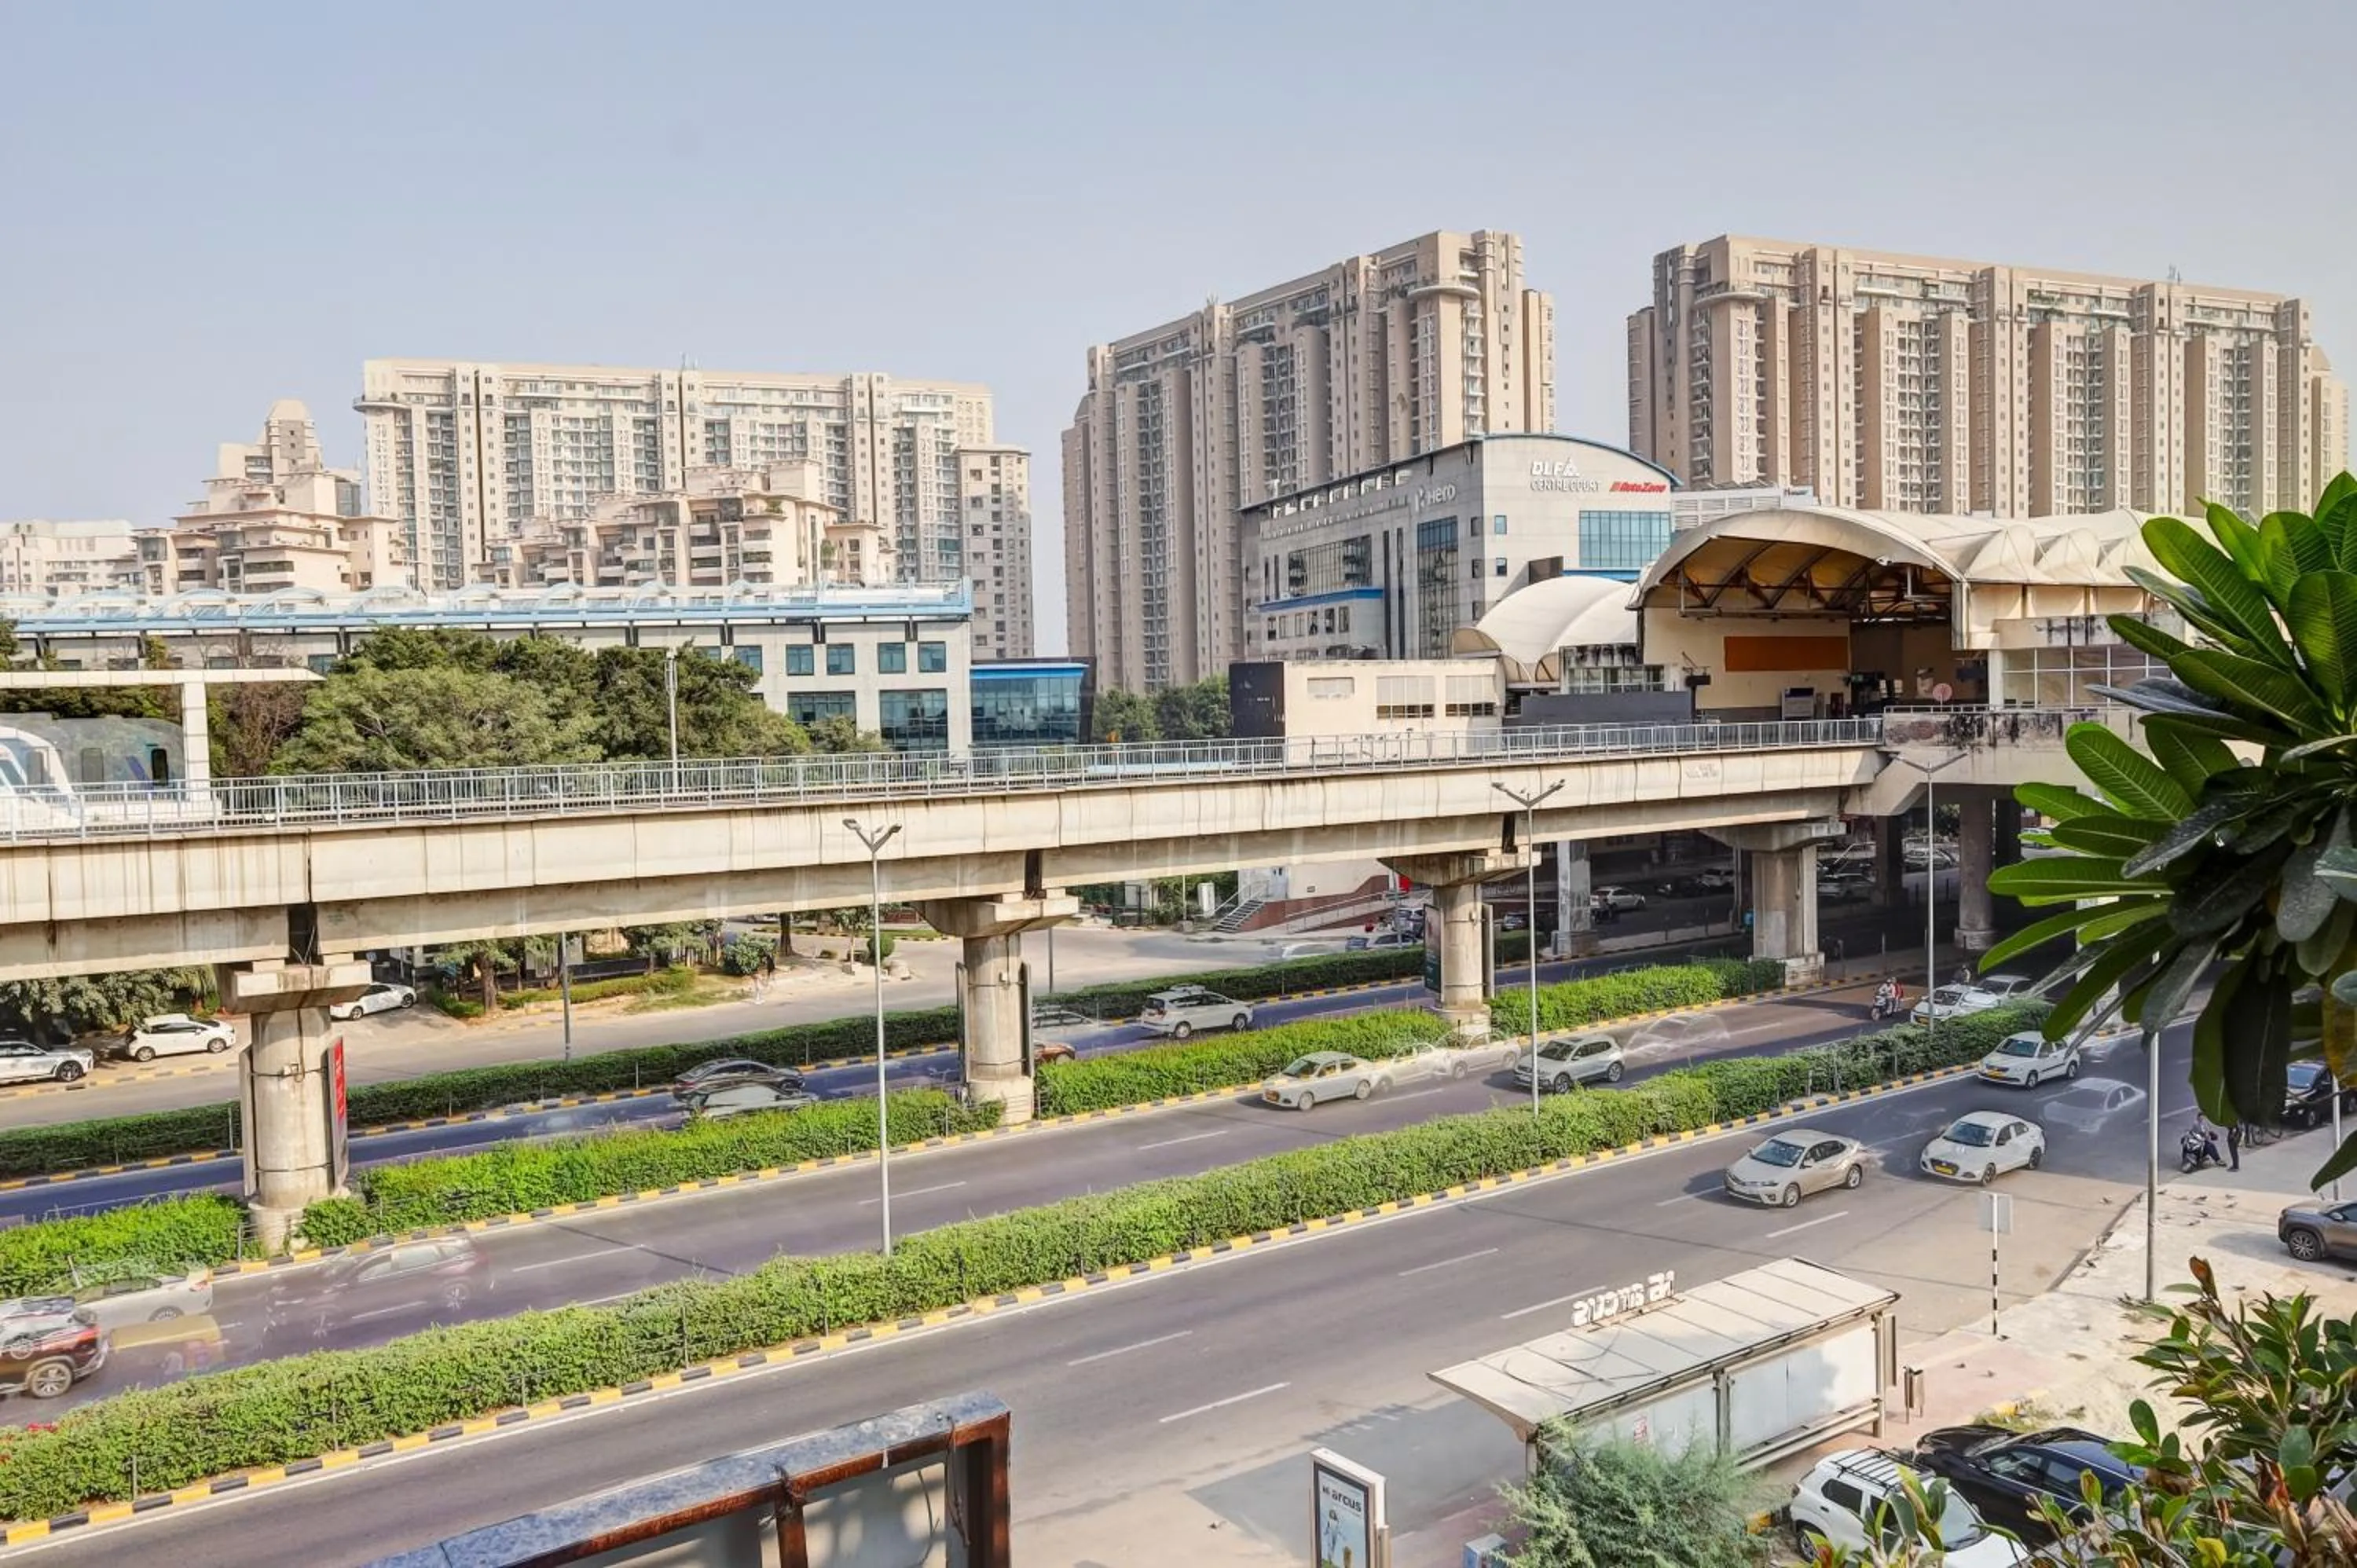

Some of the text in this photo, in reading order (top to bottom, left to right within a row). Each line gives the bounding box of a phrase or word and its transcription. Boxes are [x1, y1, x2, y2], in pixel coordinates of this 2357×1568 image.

[1530, 460, 1563, 476] DLF
[1425, 482, 1457, 504] Hero
[1332, 1489, 1362, 1511] arcus
